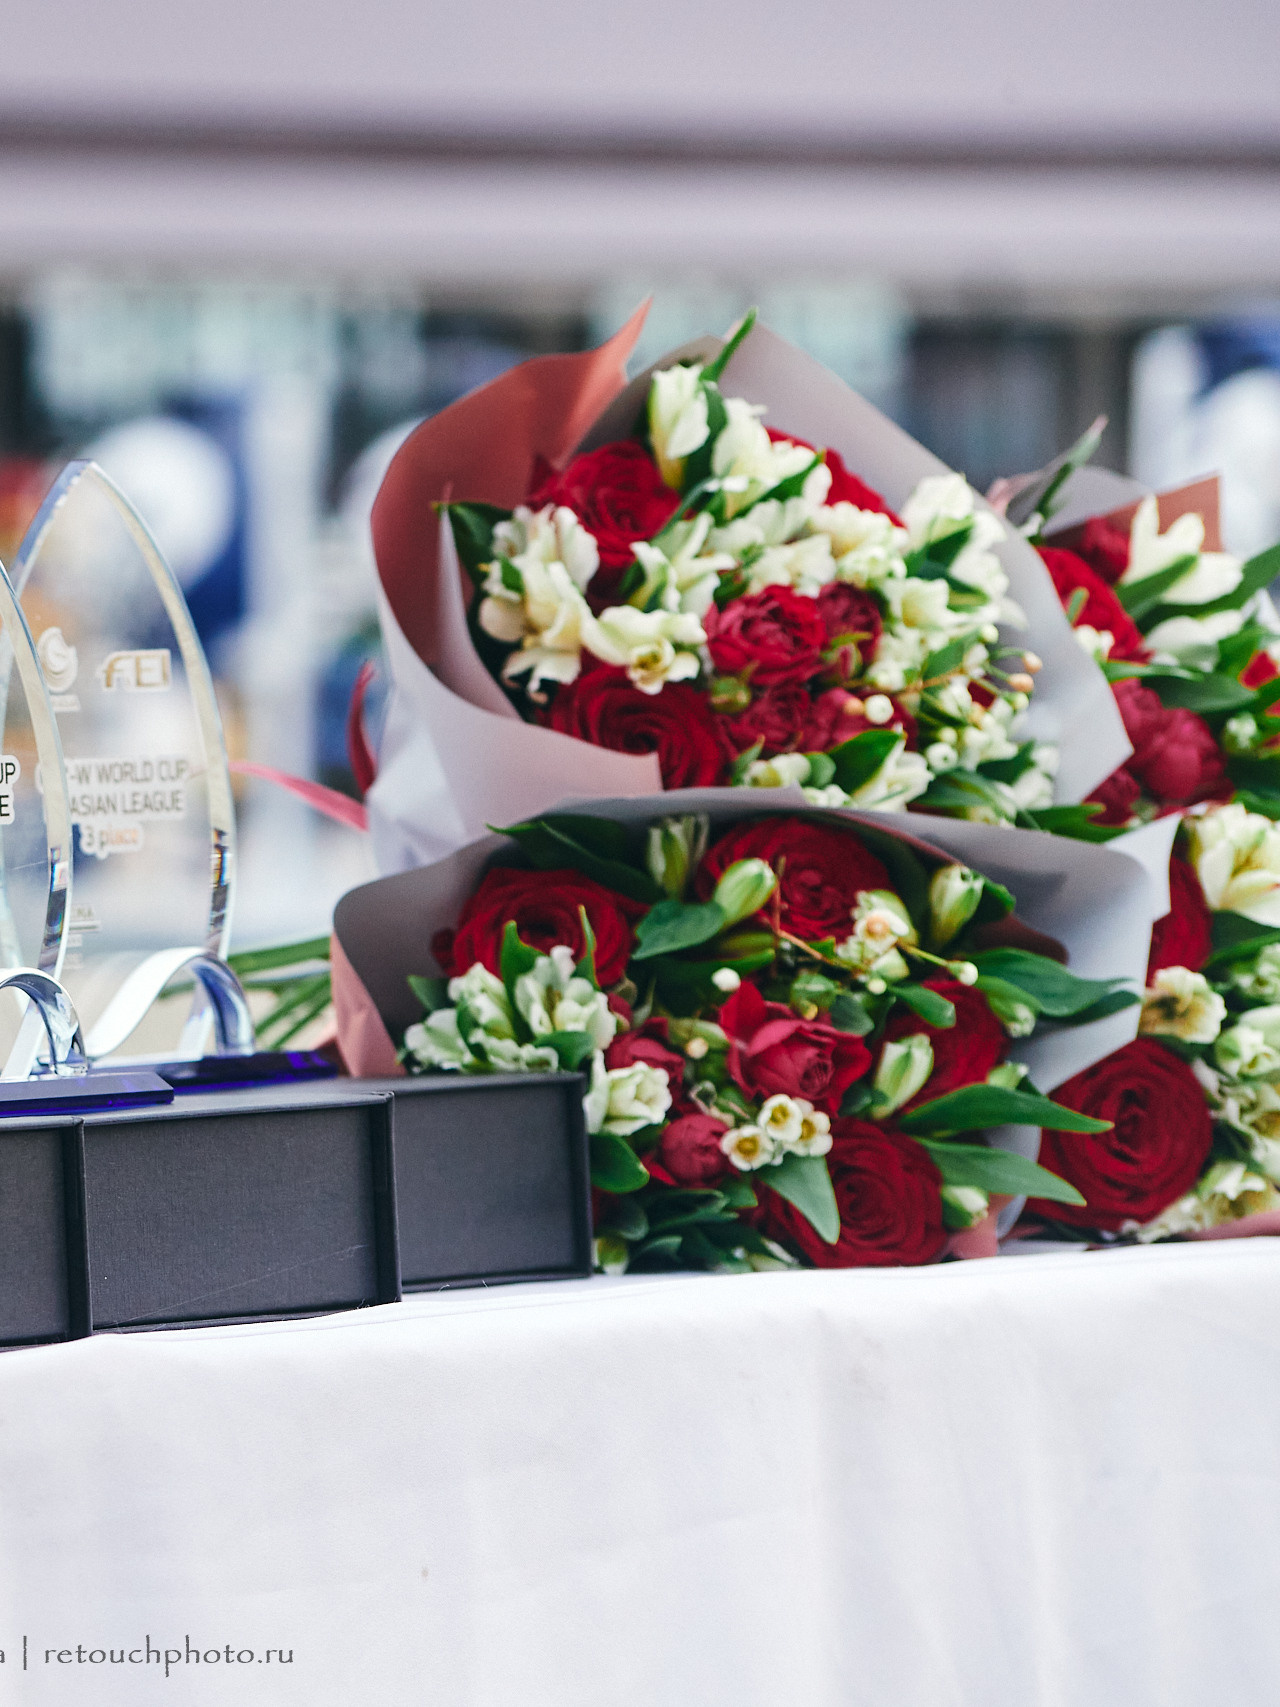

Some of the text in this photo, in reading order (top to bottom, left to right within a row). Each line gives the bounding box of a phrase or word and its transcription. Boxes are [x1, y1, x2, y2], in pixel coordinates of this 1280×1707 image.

[102, 654, 169, 688] FEI
[96, 761, 155, 784] WORLD
[158, 759, 189, 783] CUP
[70, 789, 184, 816] ASIAN LEAGUE
[85, 824, 140, 849] 3 place
